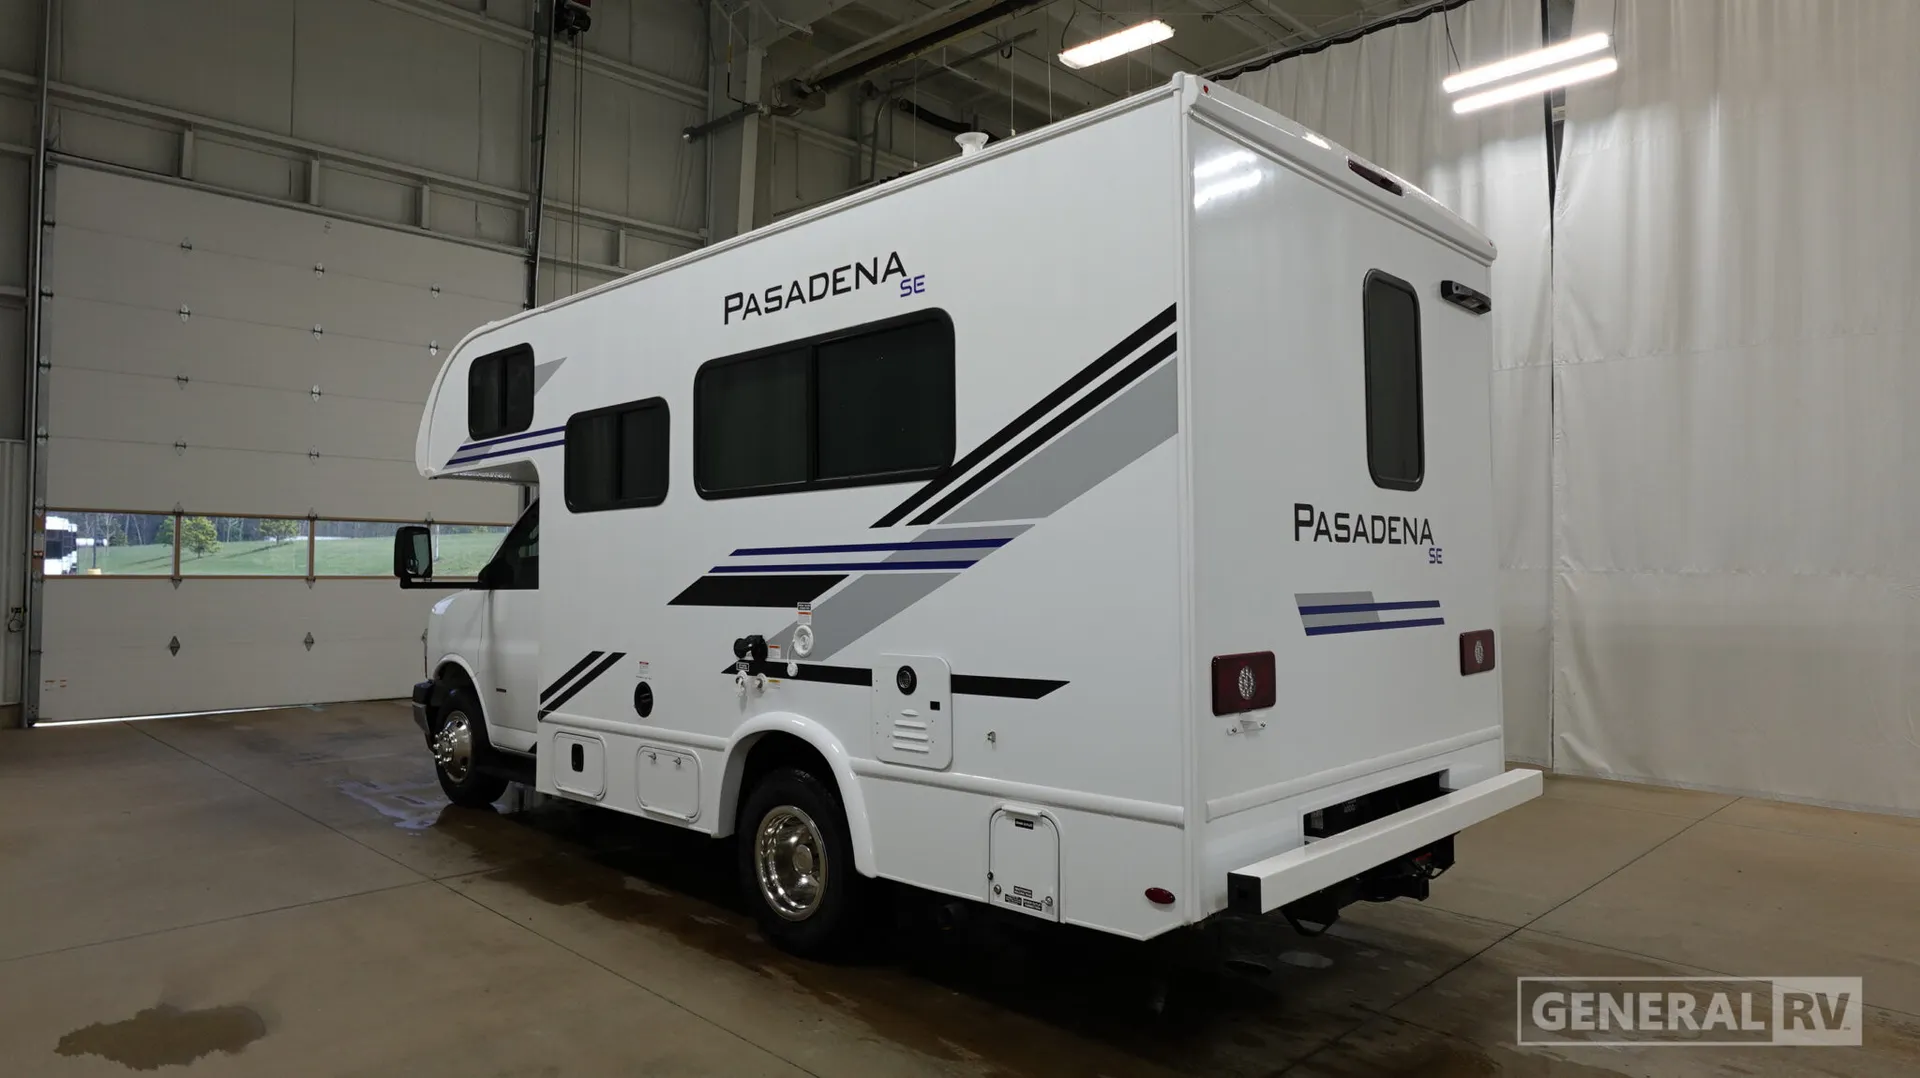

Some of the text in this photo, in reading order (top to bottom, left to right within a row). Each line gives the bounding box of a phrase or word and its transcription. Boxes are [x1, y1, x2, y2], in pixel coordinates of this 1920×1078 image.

[723, 251, 907, 325] PASADENA
[900, 275, 926, 298] SE
[1294, 503, 1434, 545] PASADENA
[1428, 548, 1443, 564] SE
